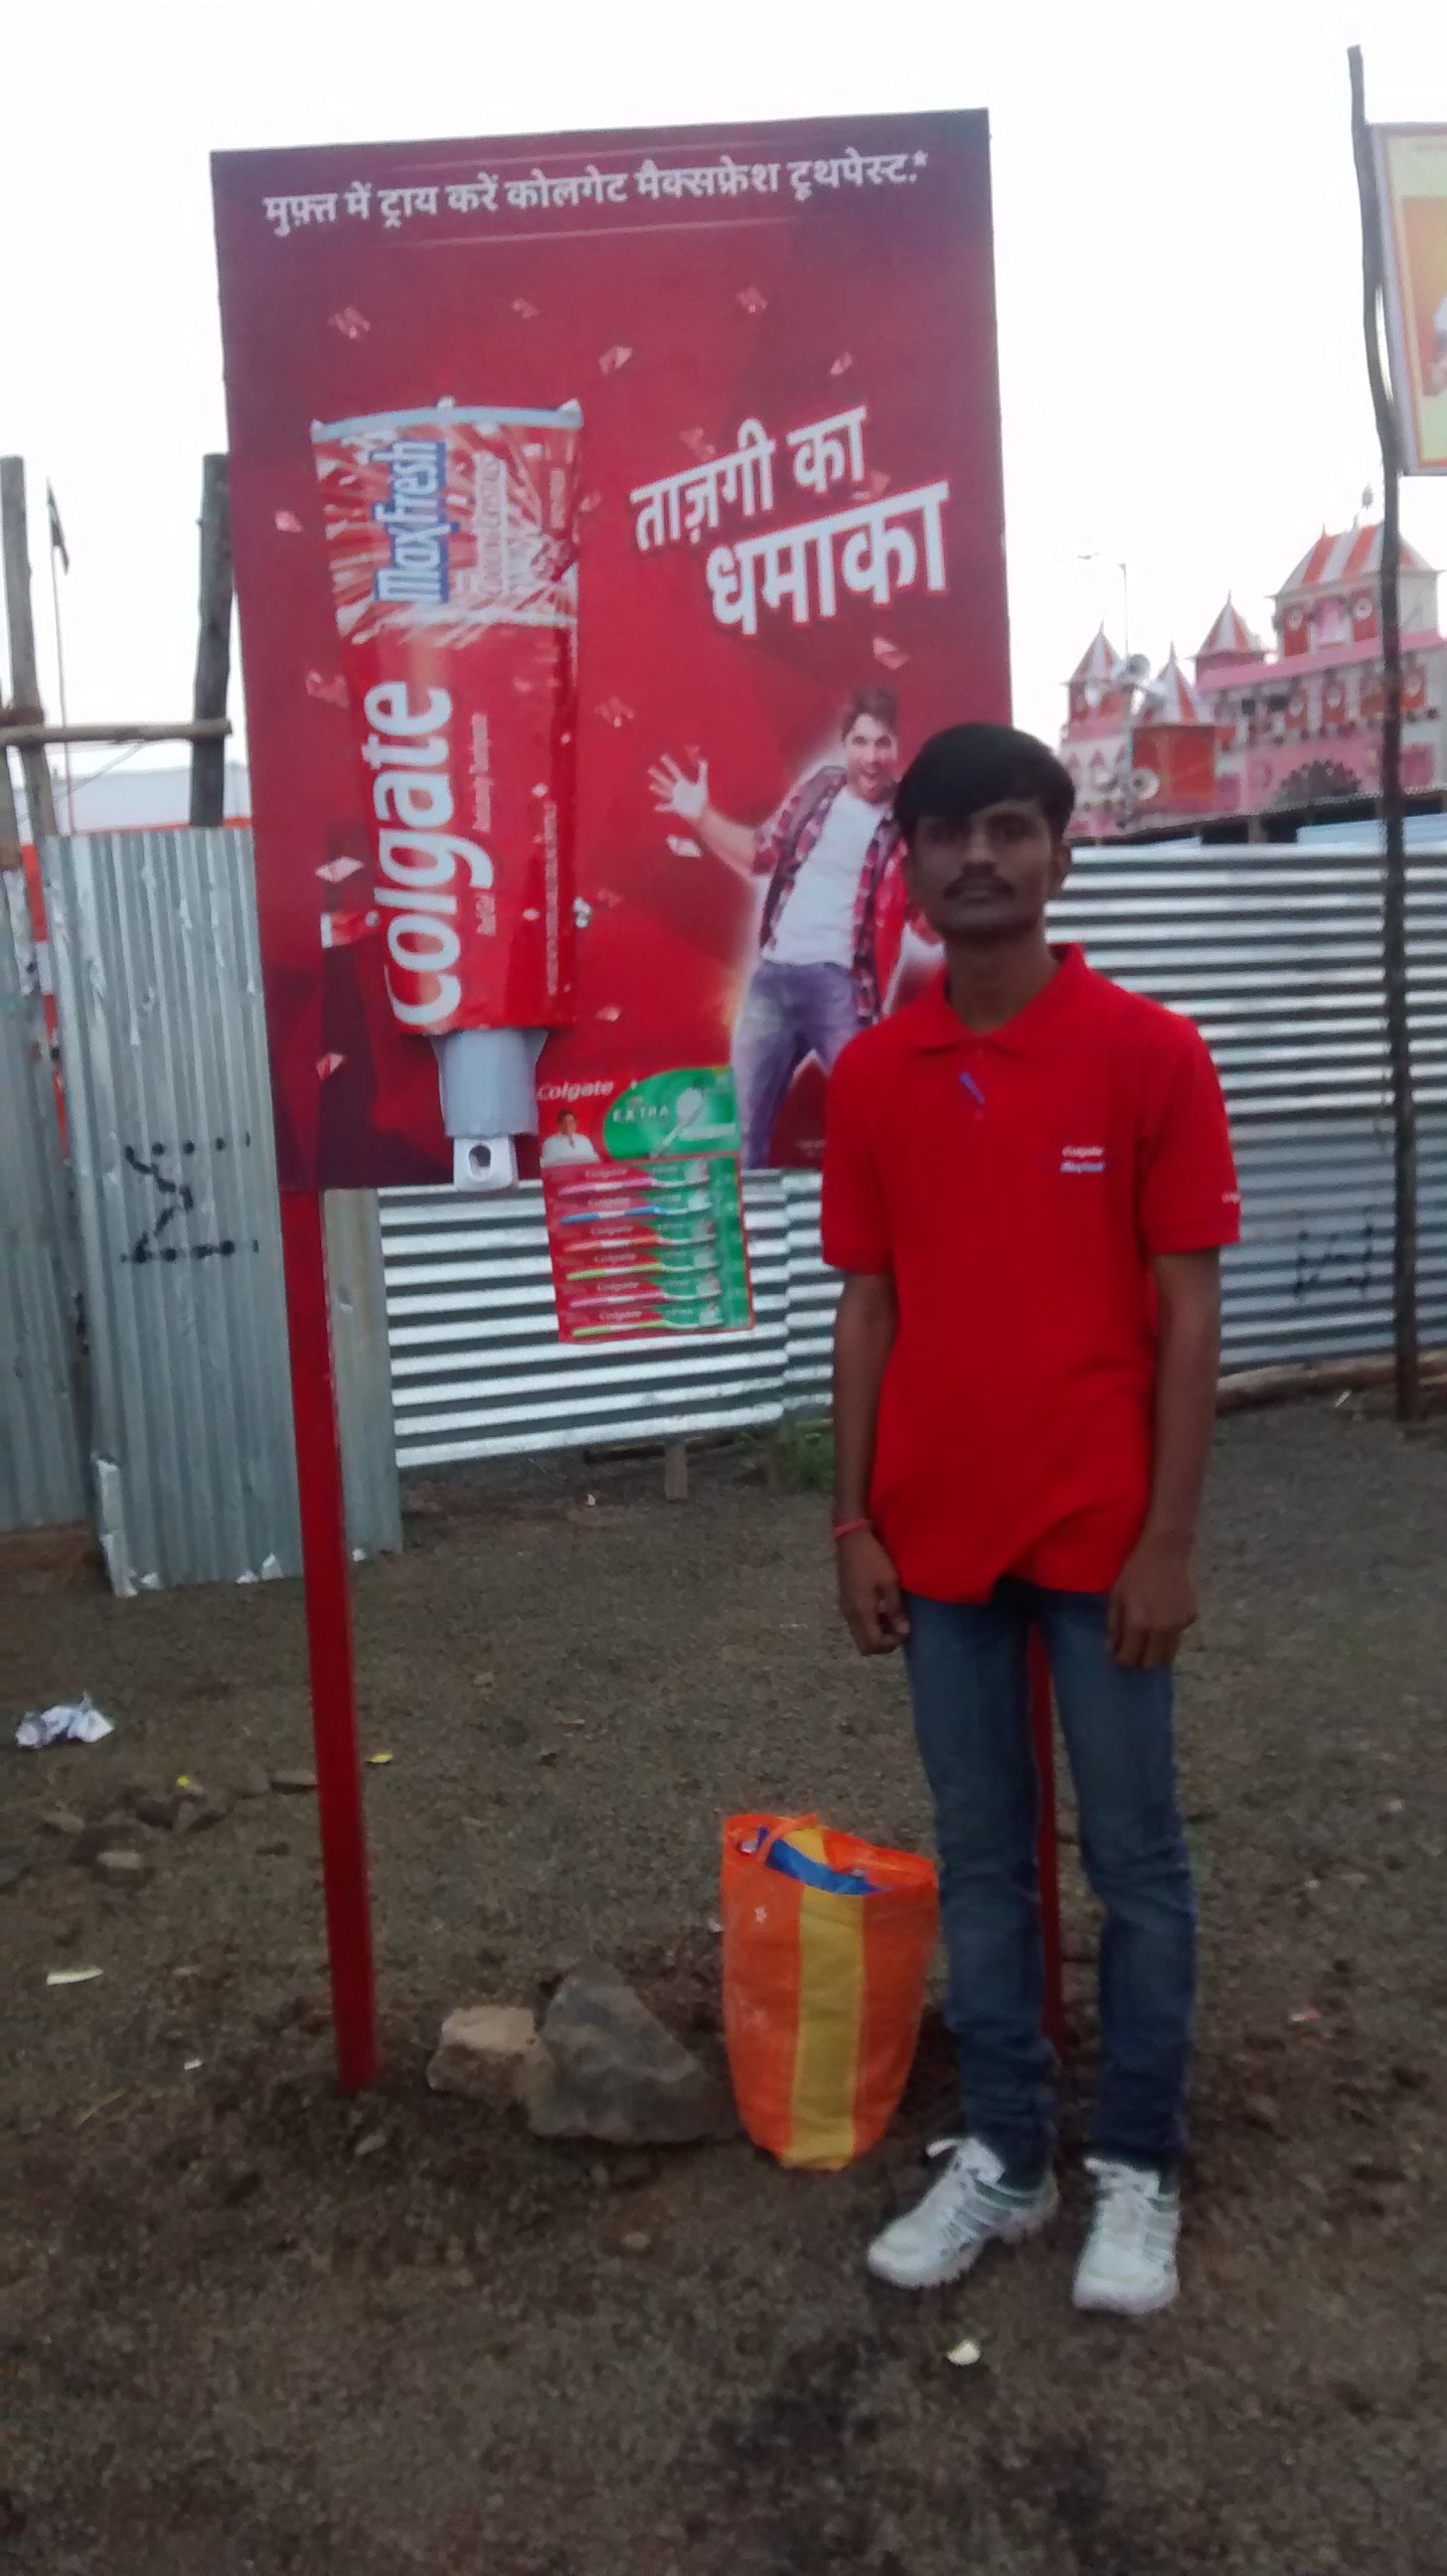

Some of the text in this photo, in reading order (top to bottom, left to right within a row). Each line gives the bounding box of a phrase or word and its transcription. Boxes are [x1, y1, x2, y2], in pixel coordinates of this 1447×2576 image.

[343, 180, 373, 221] में
[378, 186, 440, 230] ट्राय
[444, 172, 499, 214] करें
[505, 164, 629, 209] कोलगेट
[629, 417, 777, 553] ताज़गी
[786, 404, 868, 494] का
[706, 479, 950, 636] धमाका
[361, 680, 495, 1027] Colgate
[537, 1079, 614, 1102] Colgate
